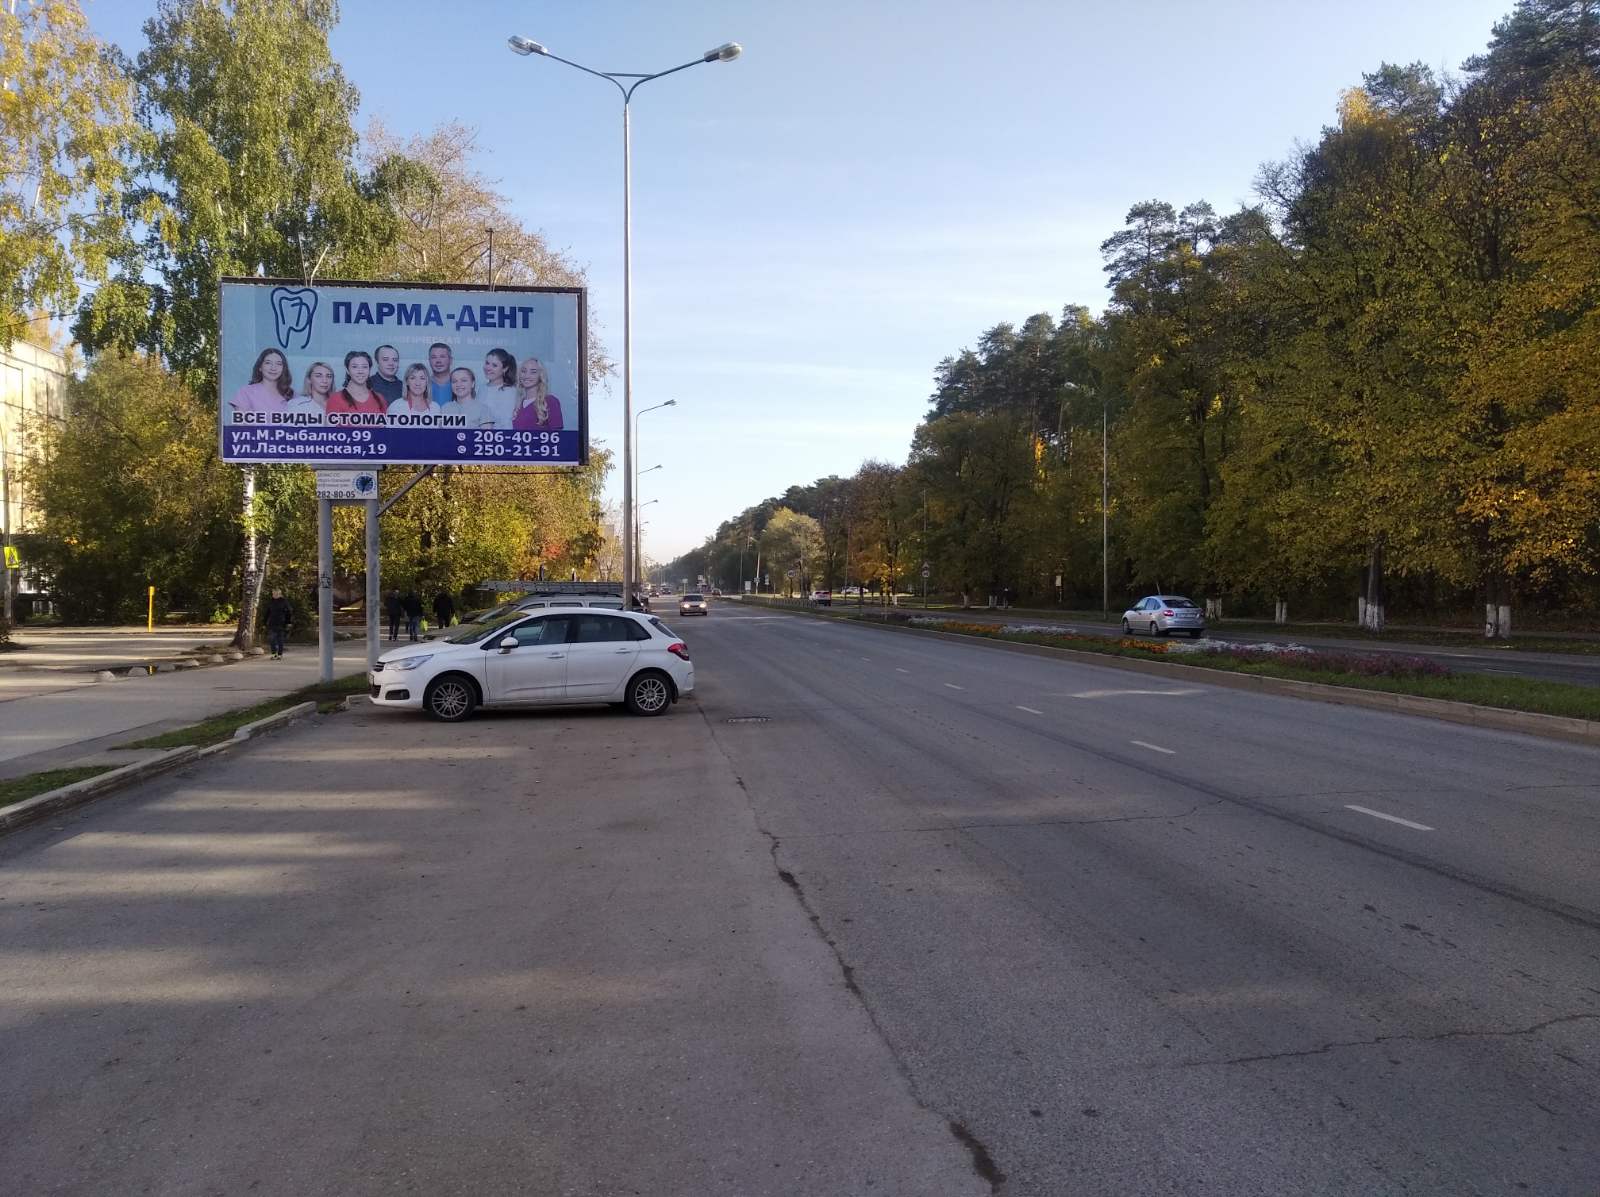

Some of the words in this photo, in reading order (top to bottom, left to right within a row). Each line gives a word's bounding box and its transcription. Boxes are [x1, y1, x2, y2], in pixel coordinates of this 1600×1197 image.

[332, 301, 534, 332] ПАРМА-ДЕНТ
[232, 412, 266, 424] ВСЕ
[271, 412, 322, 426] ВИДЫ
[328, 413, 466, 427] СТОМАТОЛОГИИ
[231, 429, 372, 443] ул.М.Рыбалко,99
[473, 431, 560, 444] 206-40-96
[231, 443, 387, 456] ул.Ласьвинская,19
[473, 444, 561, 457] 250-21-91
